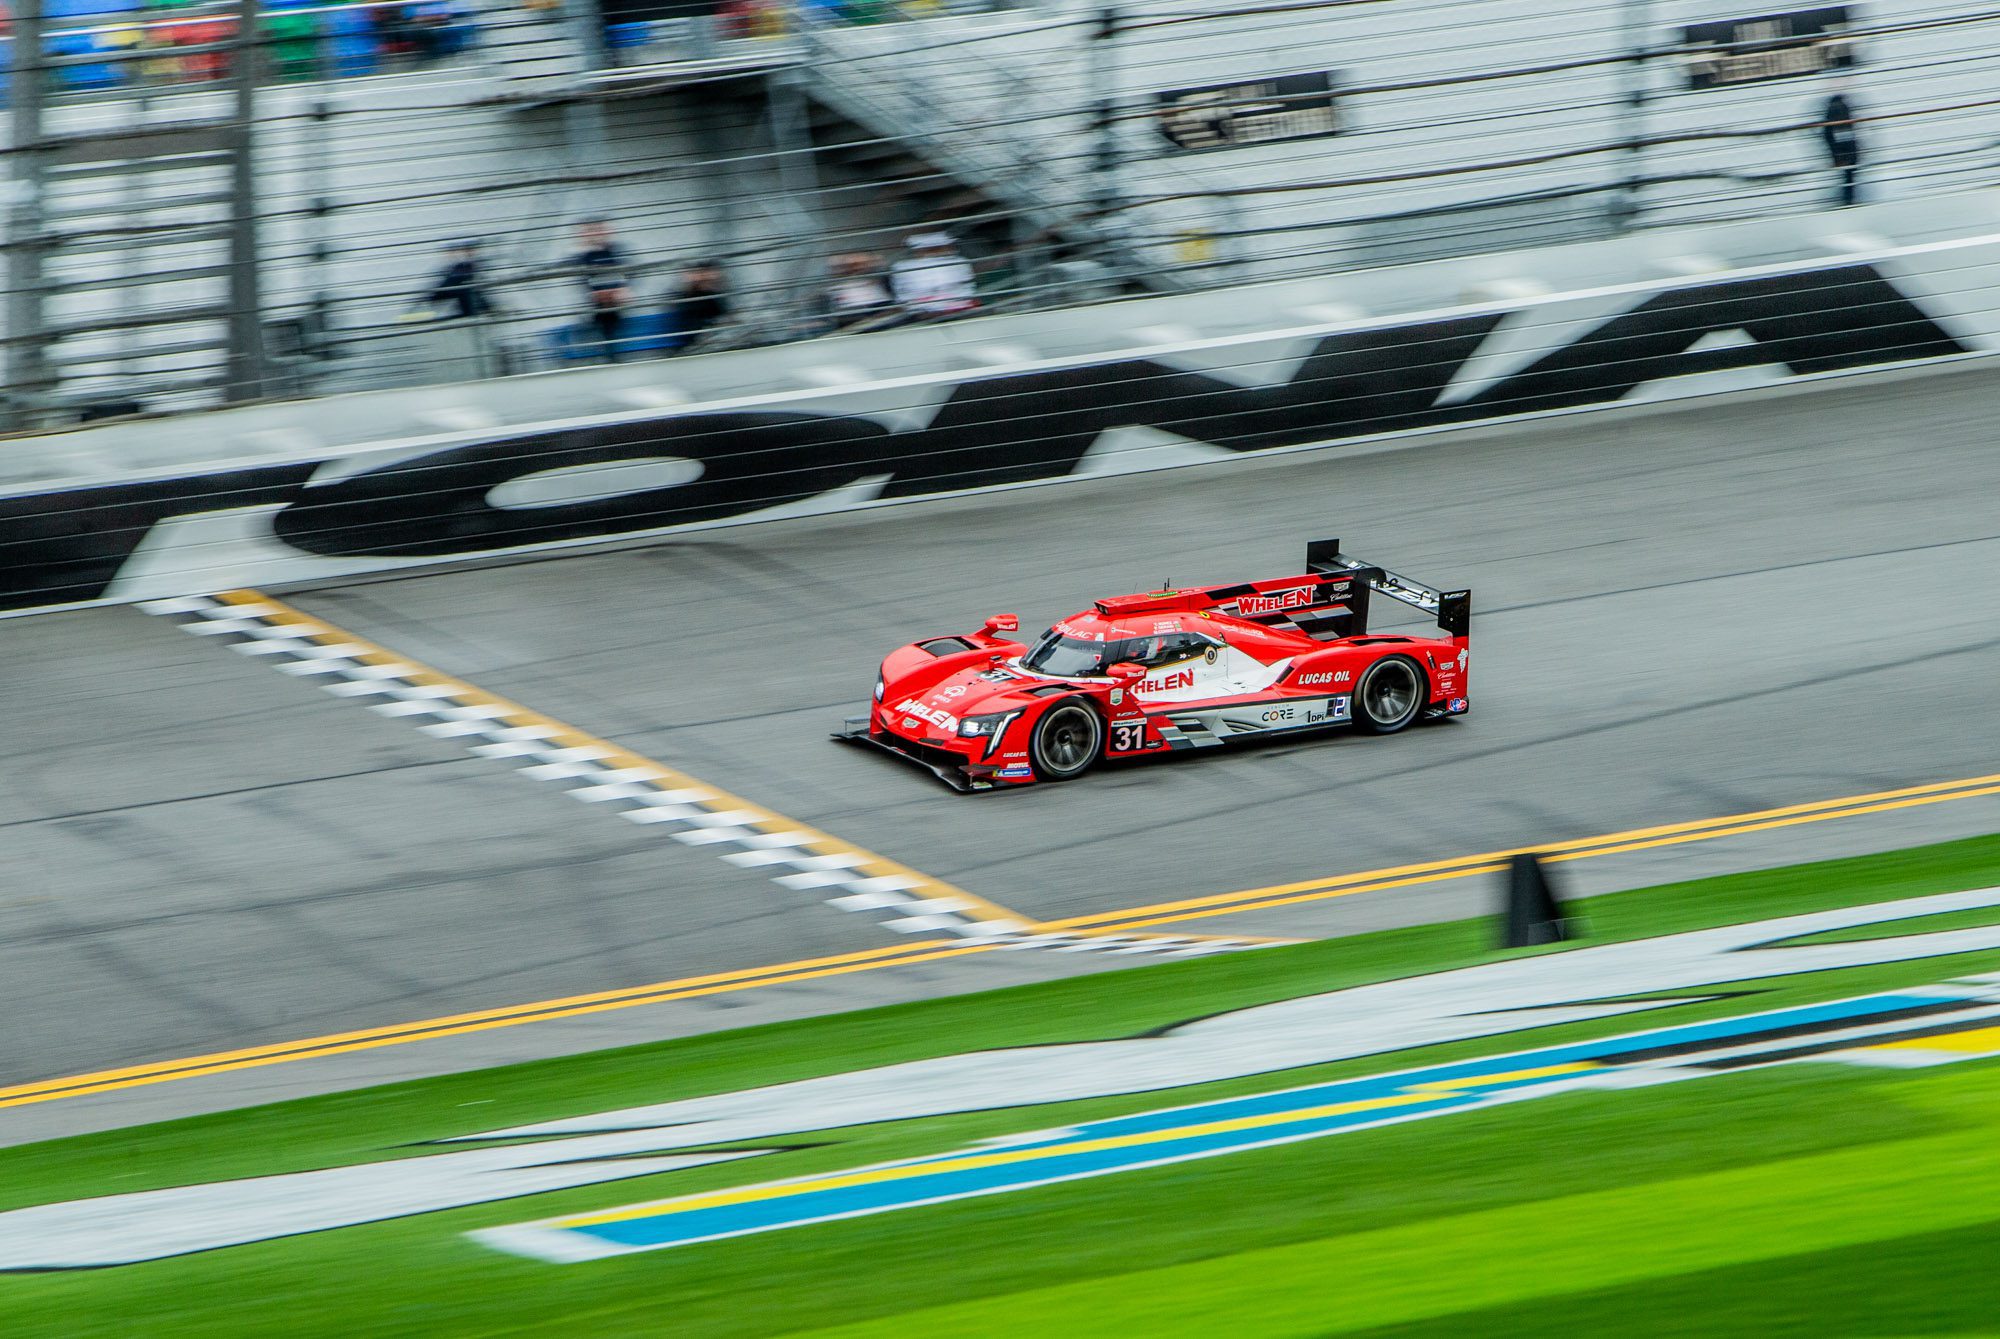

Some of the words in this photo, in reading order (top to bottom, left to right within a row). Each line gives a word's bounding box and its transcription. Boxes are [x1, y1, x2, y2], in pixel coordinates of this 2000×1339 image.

[1236, 585, 1312, 616] WHELEN
[1133, 667, 1194, 695] HELEN
[1298, 672, 1334, 685] LUCAS
[1334, 671, 1351, 682] OIL
[894, 698, 959, 732] WHELEN
[1262, 708, 1294, 722] CORE
[1115, 725, 1143, 751] 31
